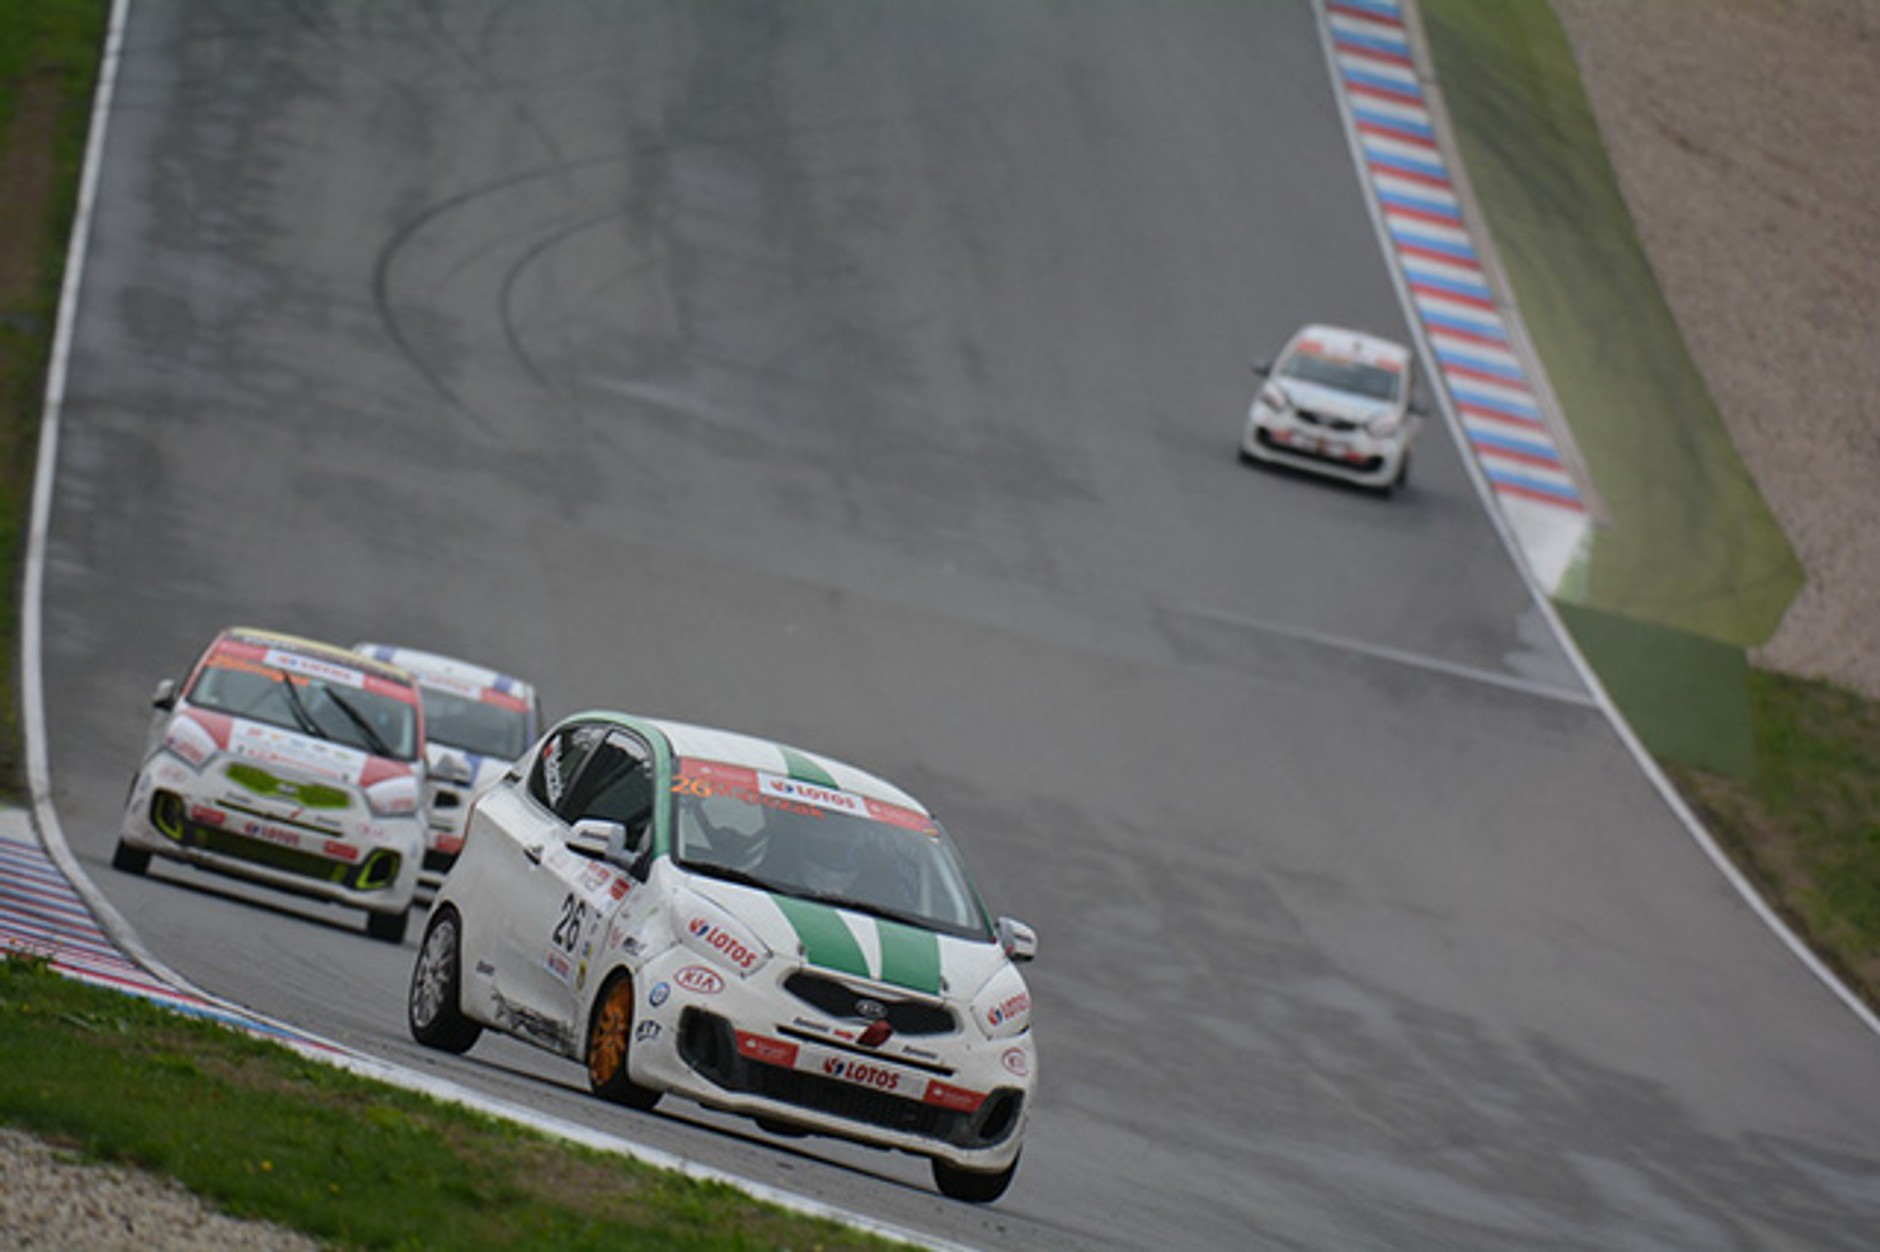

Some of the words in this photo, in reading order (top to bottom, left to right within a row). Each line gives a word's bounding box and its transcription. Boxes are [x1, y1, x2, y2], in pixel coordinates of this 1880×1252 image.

[670, 774, 713, 798] 26
[796, 784, 856, 810] LOTOS
[552, 893, 586, 953] 26
[705, 926, 757, 968] LOTOS
[844, 1061, 900, 1089] LOTOS
